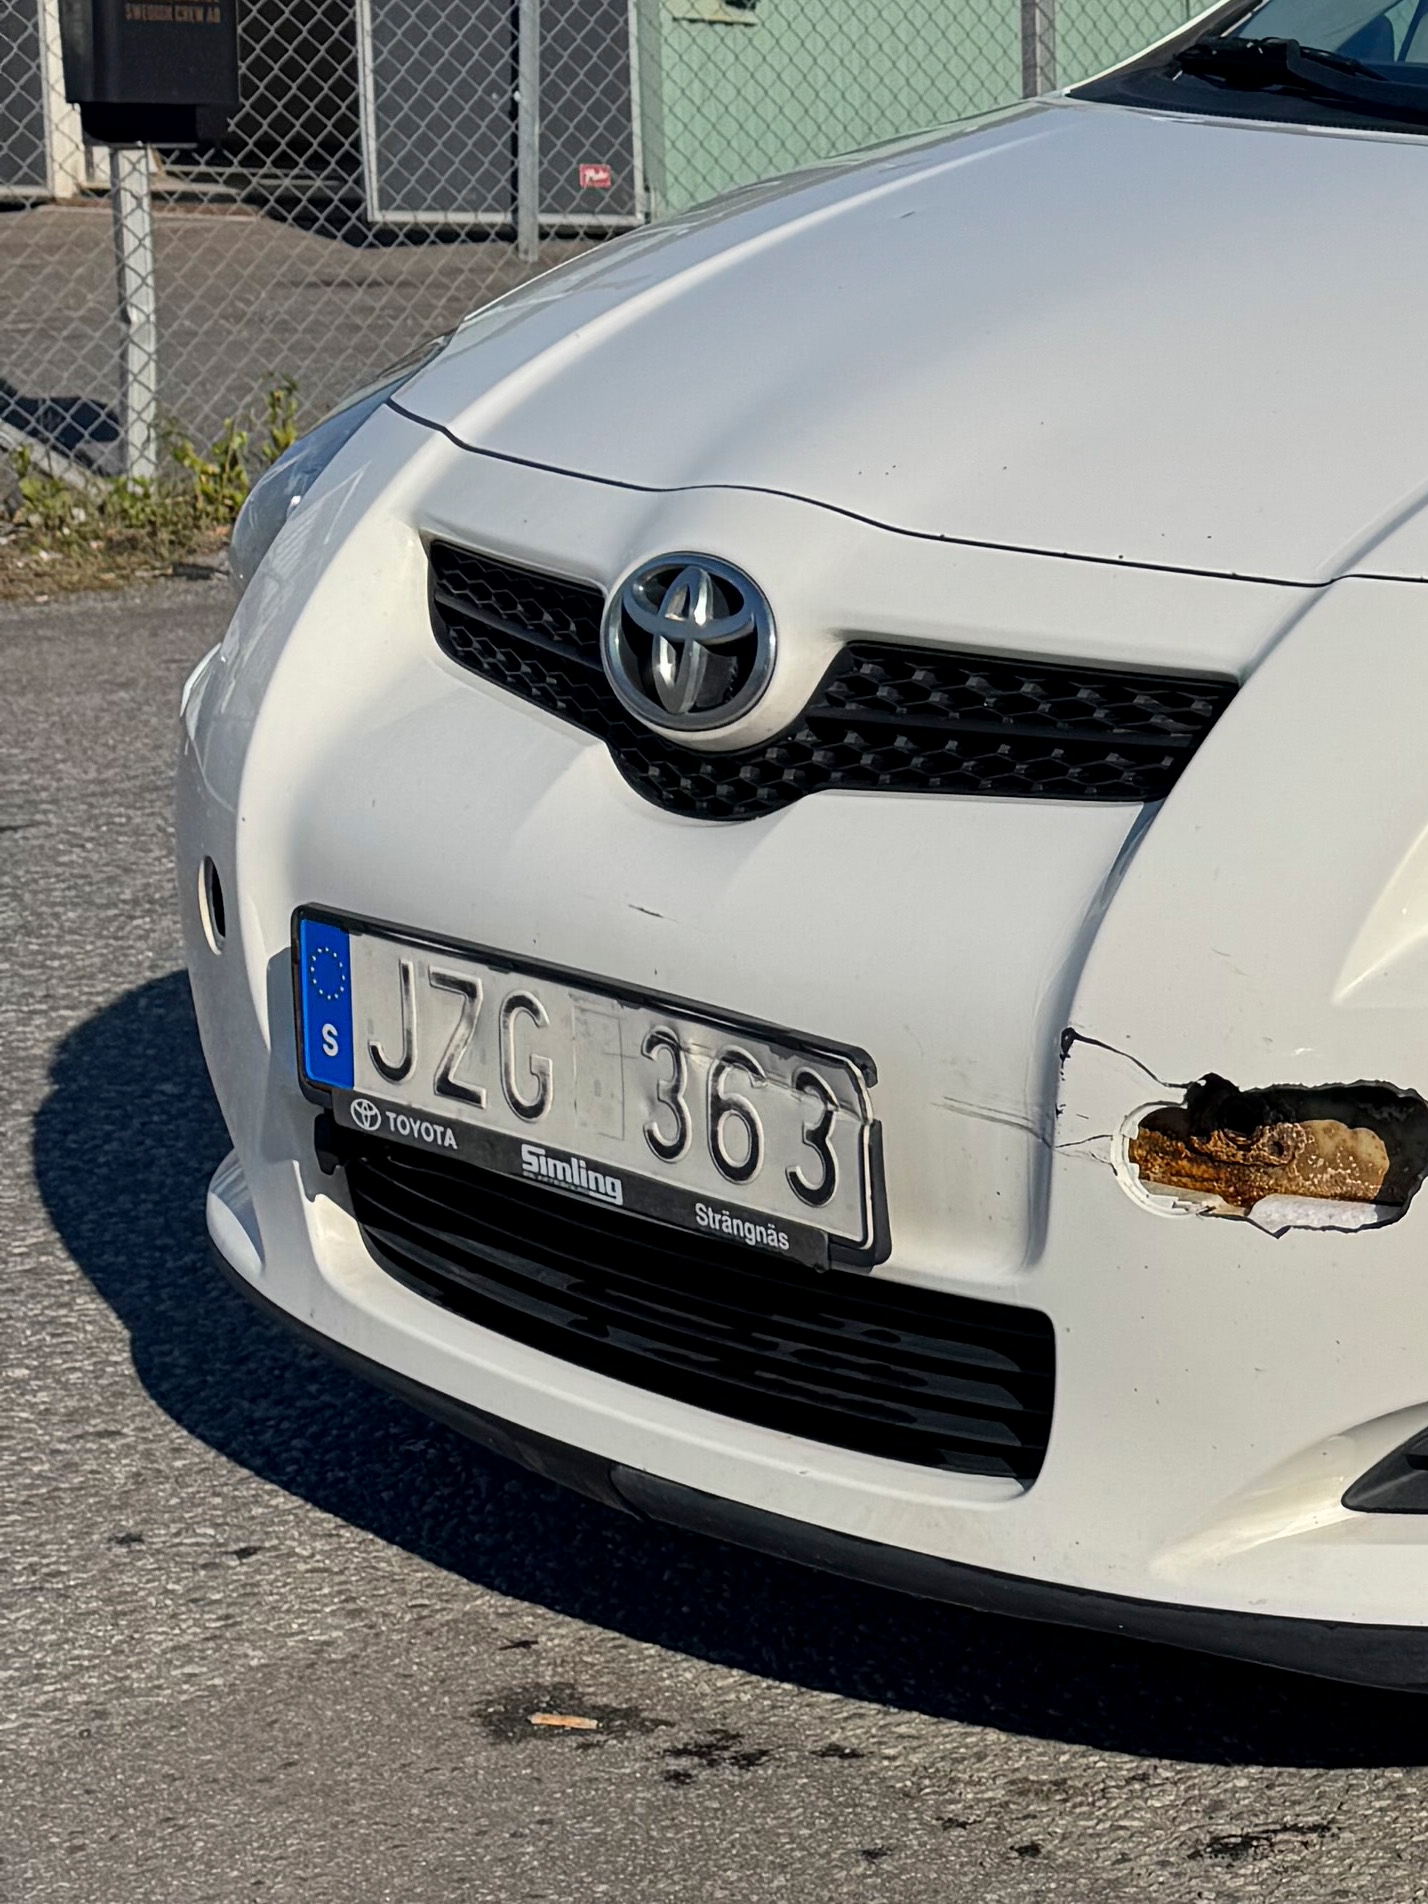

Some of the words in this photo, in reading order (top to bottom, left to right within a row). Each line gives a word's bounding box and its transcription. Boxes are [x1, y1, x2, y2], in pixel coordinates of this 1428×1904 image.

[322, 1023, 339, 1056] S
[368, 958, 553, 1123] JZG
[641, 1025, 839, 1208] 363
[385, 1111, 458, 1150] TOYOTA
[521, 1143, 623, 1206] Simling
[695, 1202, 790, 1251] Strängnäs
